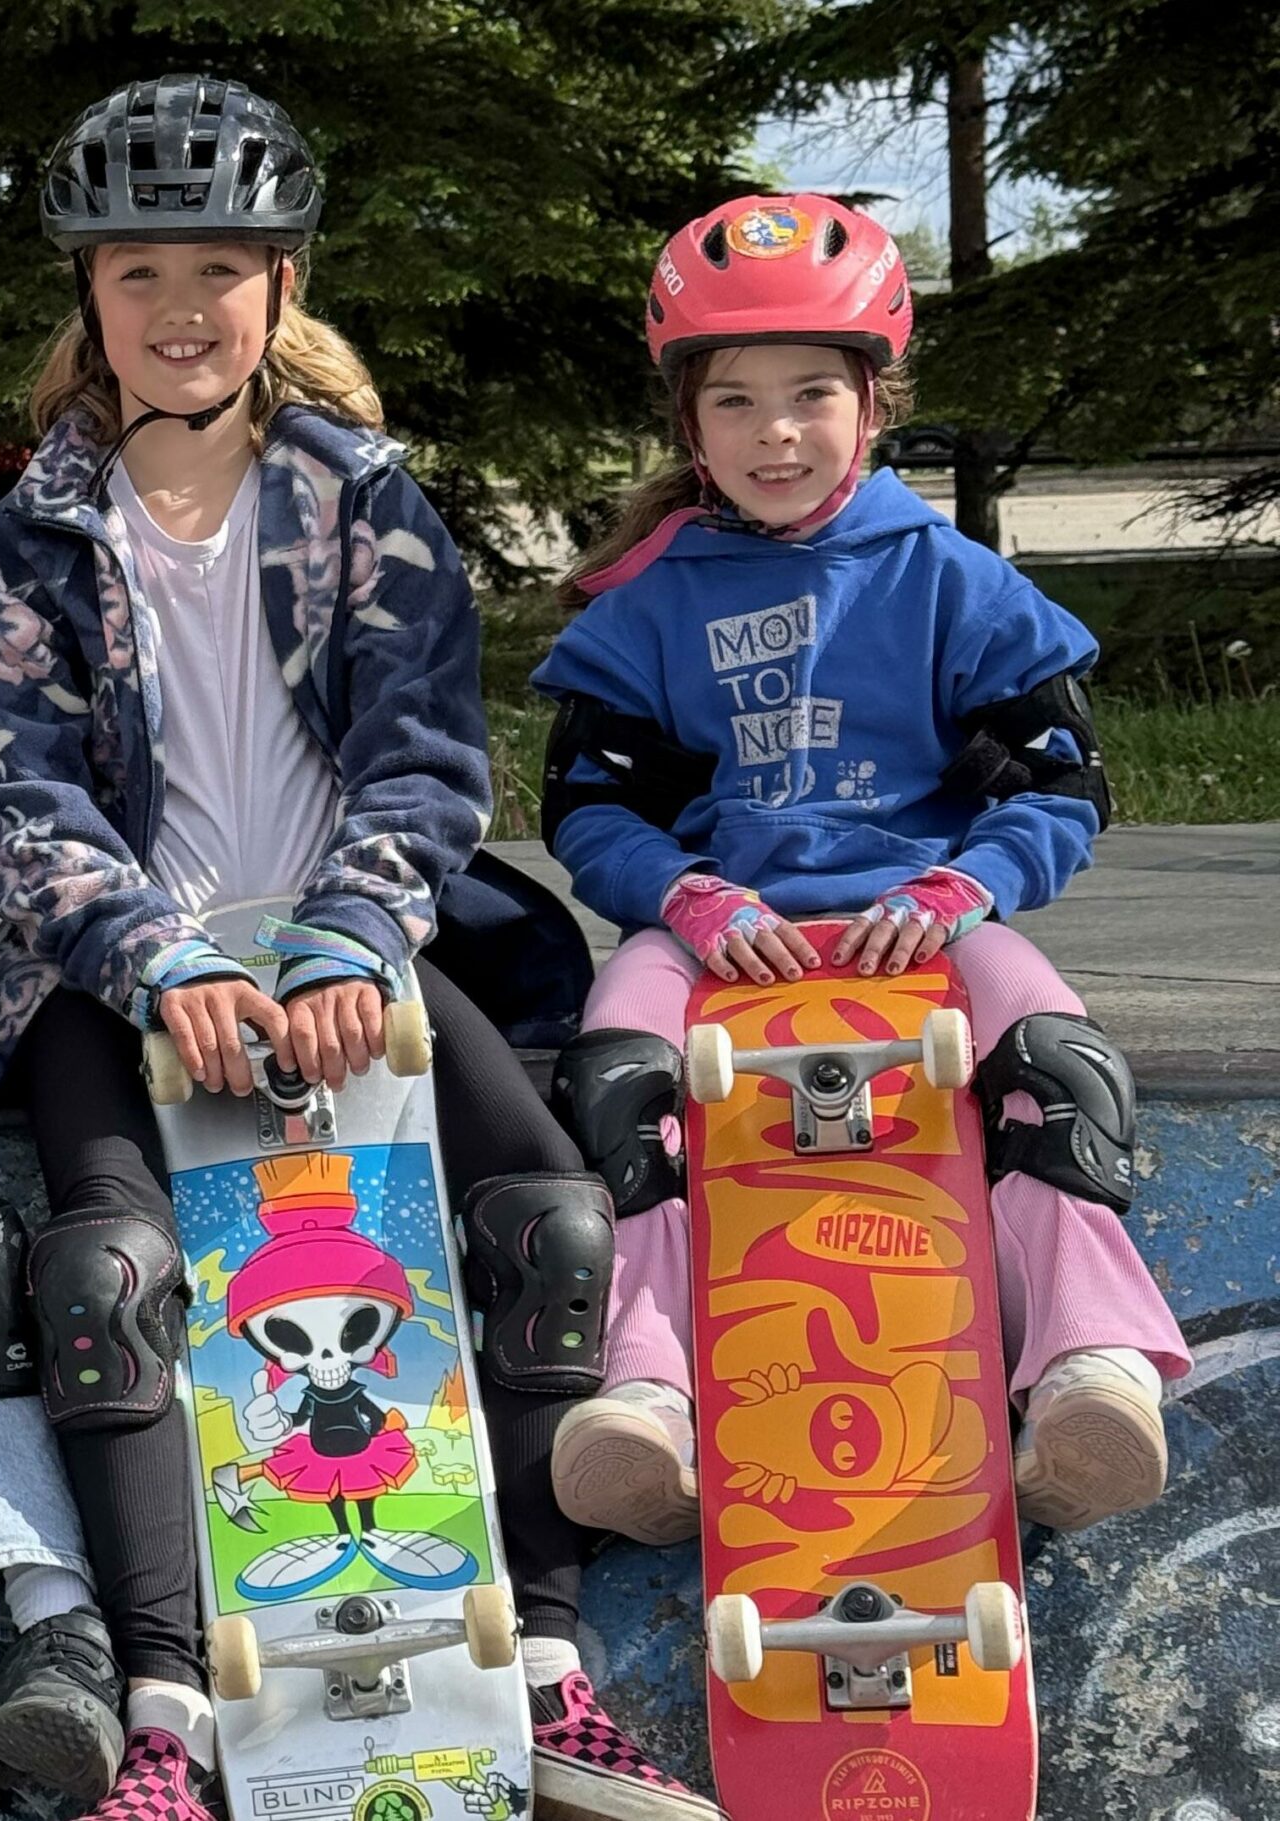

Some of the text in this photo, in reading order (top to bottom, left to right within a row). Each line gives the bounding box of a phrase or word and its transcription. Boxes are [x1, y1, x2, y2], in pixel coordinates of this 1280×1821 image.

[717, 664, 796, 710] TO
[816, 1213, 931, 1257] RIPZONE
[262, 1784, 356, 1810] BLIND
[831, 1796, 920, 1811] RIPZONE
